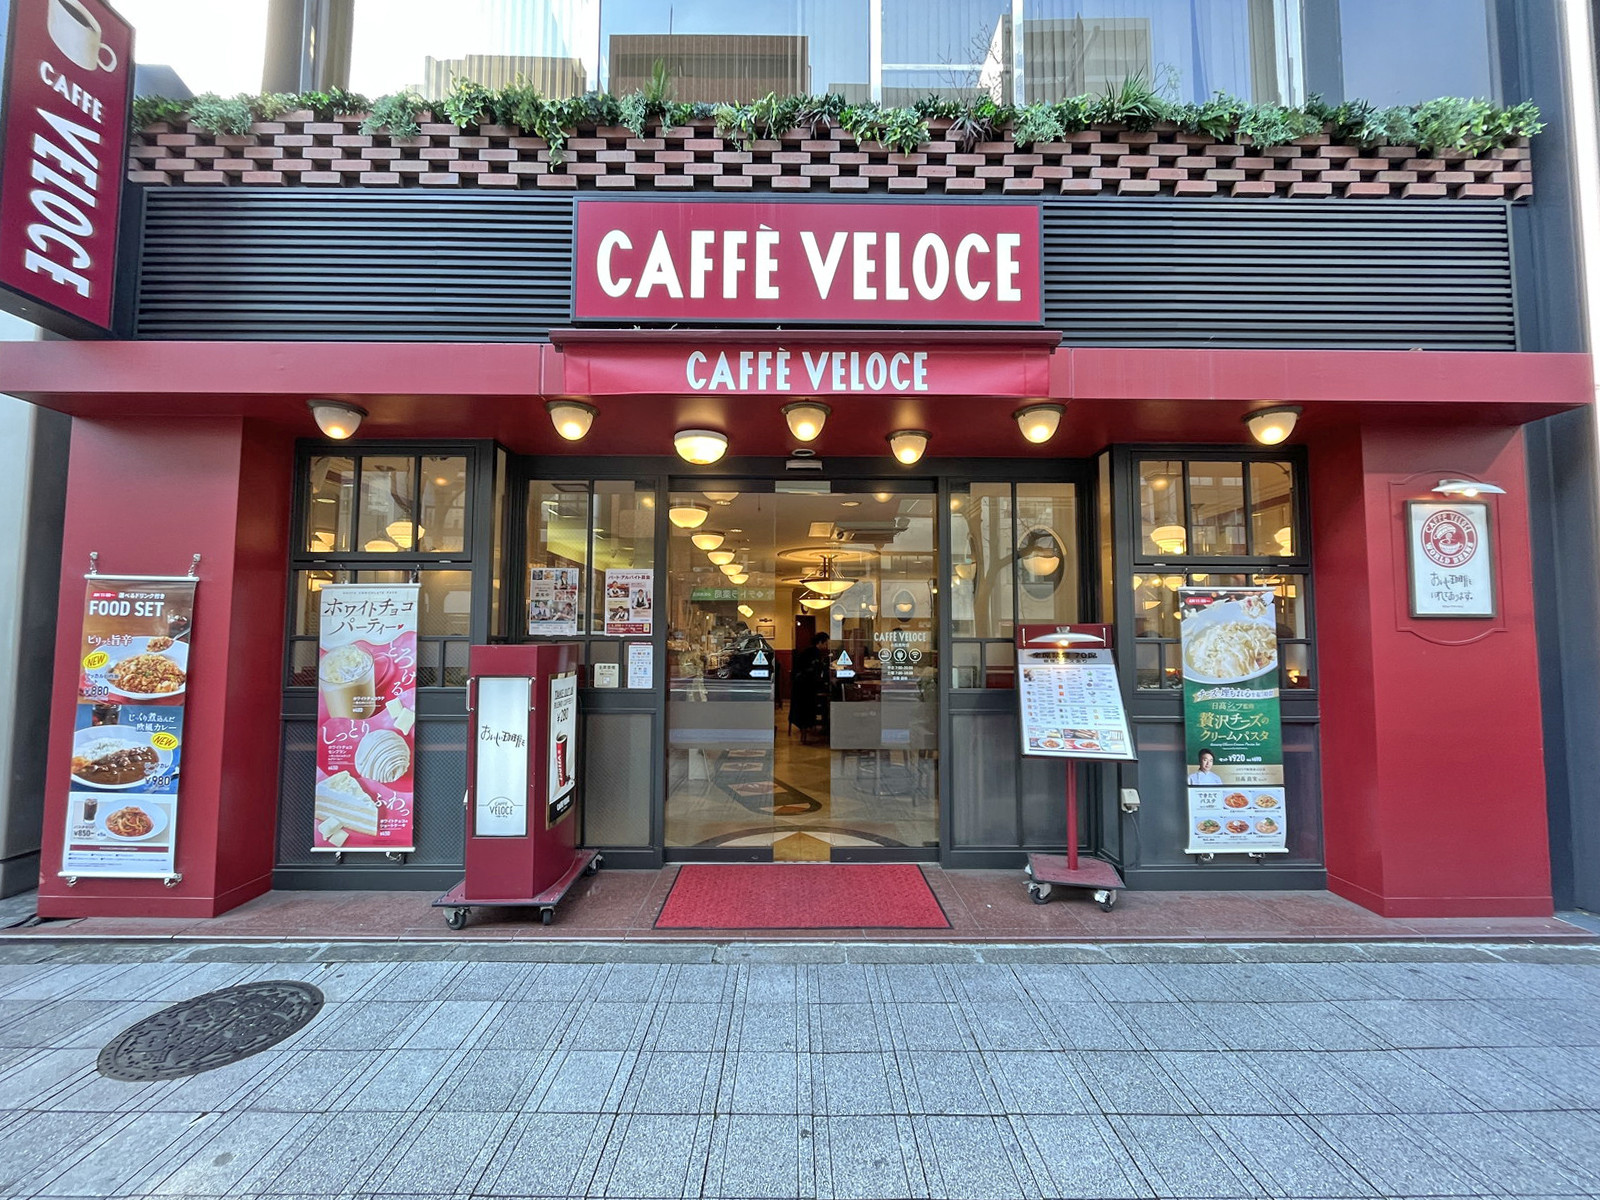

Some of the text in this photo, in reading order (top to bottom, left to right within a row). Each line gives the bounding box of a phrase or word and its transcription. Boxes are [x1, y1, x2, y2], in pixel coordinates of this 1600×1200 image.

[25, 107, 101, 298] VELOCE
[597, 224, 1021, 302] CAFFÈ VELOCE
[686, 347, 928, 391] CAFFÈ VELOCE
[89, 600, 165, 617] FOOD SET
[324, 598, 414, 618] ホワイトチョコ
[328, 618, 397, 635] パーティー
[87, 634, 132, 646] ピリッと旨辛
[899, 632, 926, 642] VELOCE
[86, 653, 106, 668] NEW
[388, 640, 416, 696] とろける
[85, 686, 109, 696] ¥880
[136, 723, 177, 732] 欧風カレー
[1199, 712, 1270, 730] 贅沢チーズの
[322, 719, 370, 745] しっとり
[1200, 730, 1270, 742] クリームパスタ
[154, 735, 176, 747] NEW
[1228, 753, 1246, 762] ¥920
[145, 775, 171, 786] ¥980
[374, 791, 410, 816] ふわっ
[489, 805, 513, 815] VELOCE
